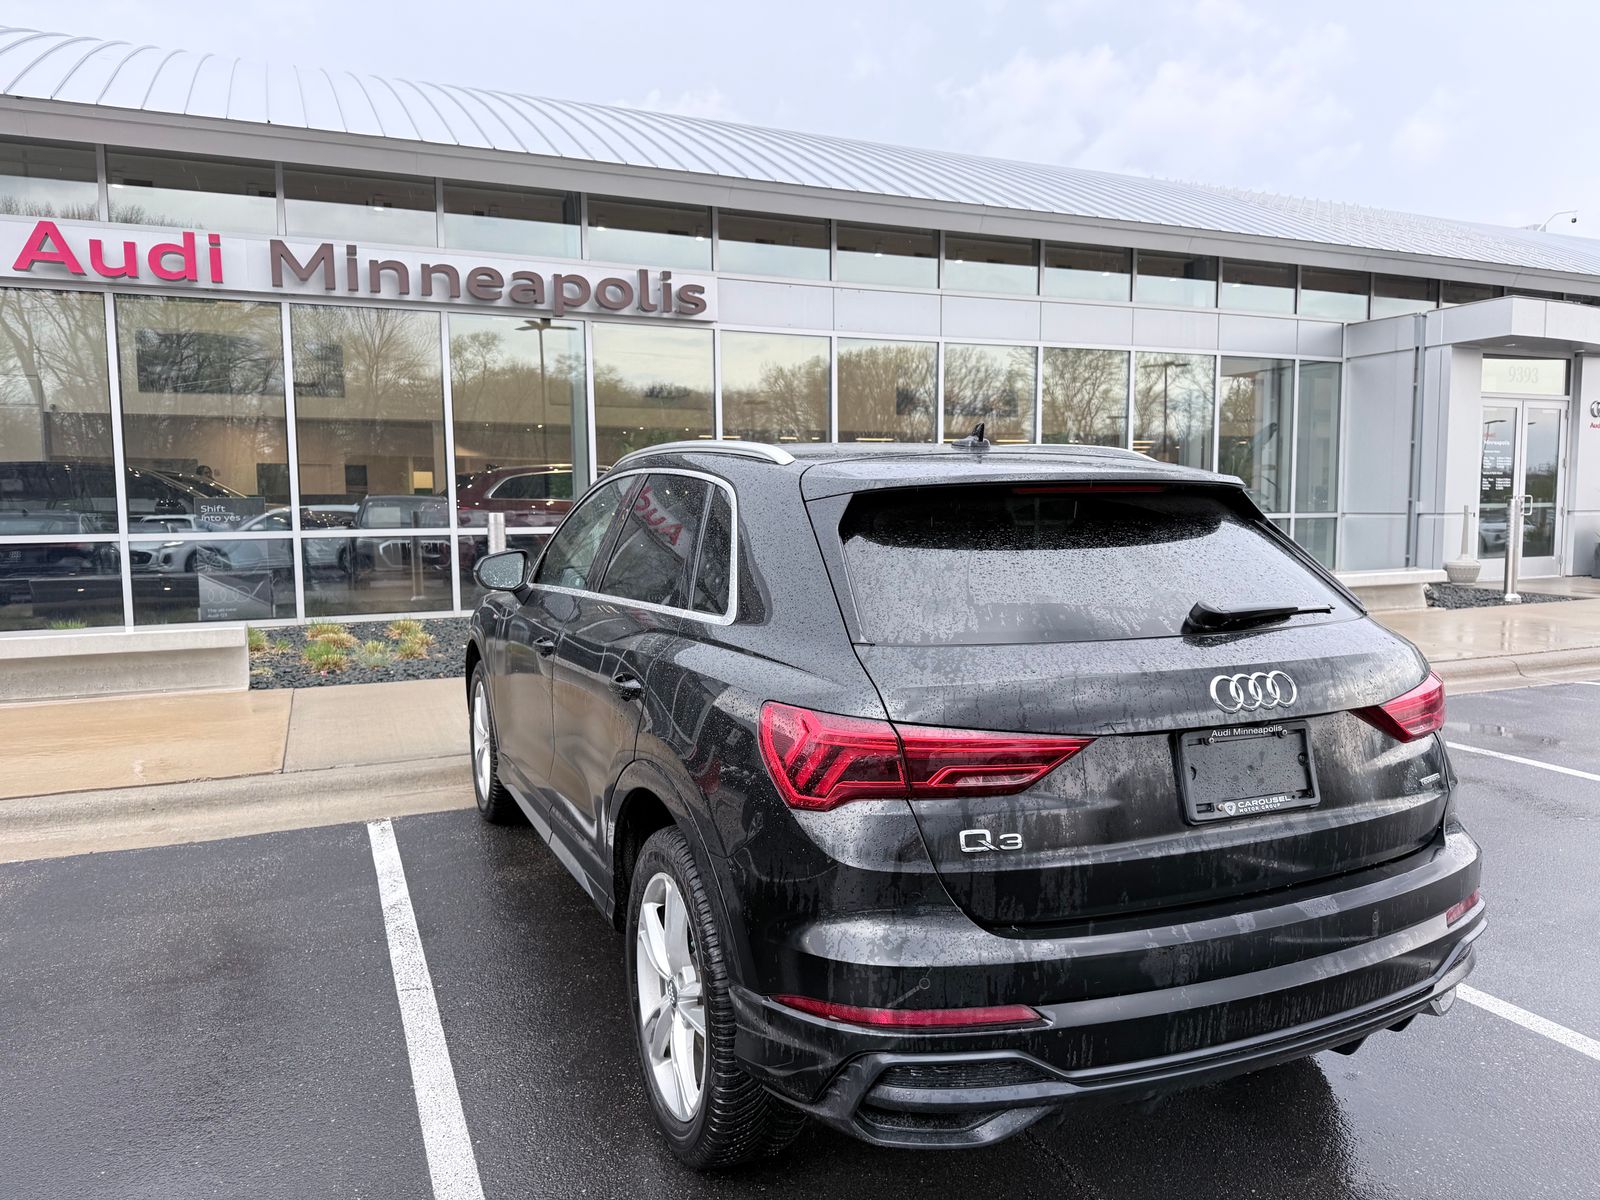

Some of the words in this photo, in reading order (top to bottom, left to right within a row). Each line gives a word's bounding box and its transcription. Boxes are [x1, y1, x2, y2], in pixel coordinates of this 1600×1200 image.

[12, 220, 224, 284] Audi
[269, 239, 707, 317] Minneapolis
[1508, 366, 1539, 384] 9393
[200, 505, 226, 513] Shift
[201, 514, 221, 522] into
[223, 515, 241, 523] yes
[1211, 729, 1231, 737] Audi
[1233, 725, 1283, 736] Minneapolis
[1238, 796, 1291, 807] CAROUSEL
[1239, 805, 1259, 813] MOTOR
[959, 829, 1023, 853] Q3
